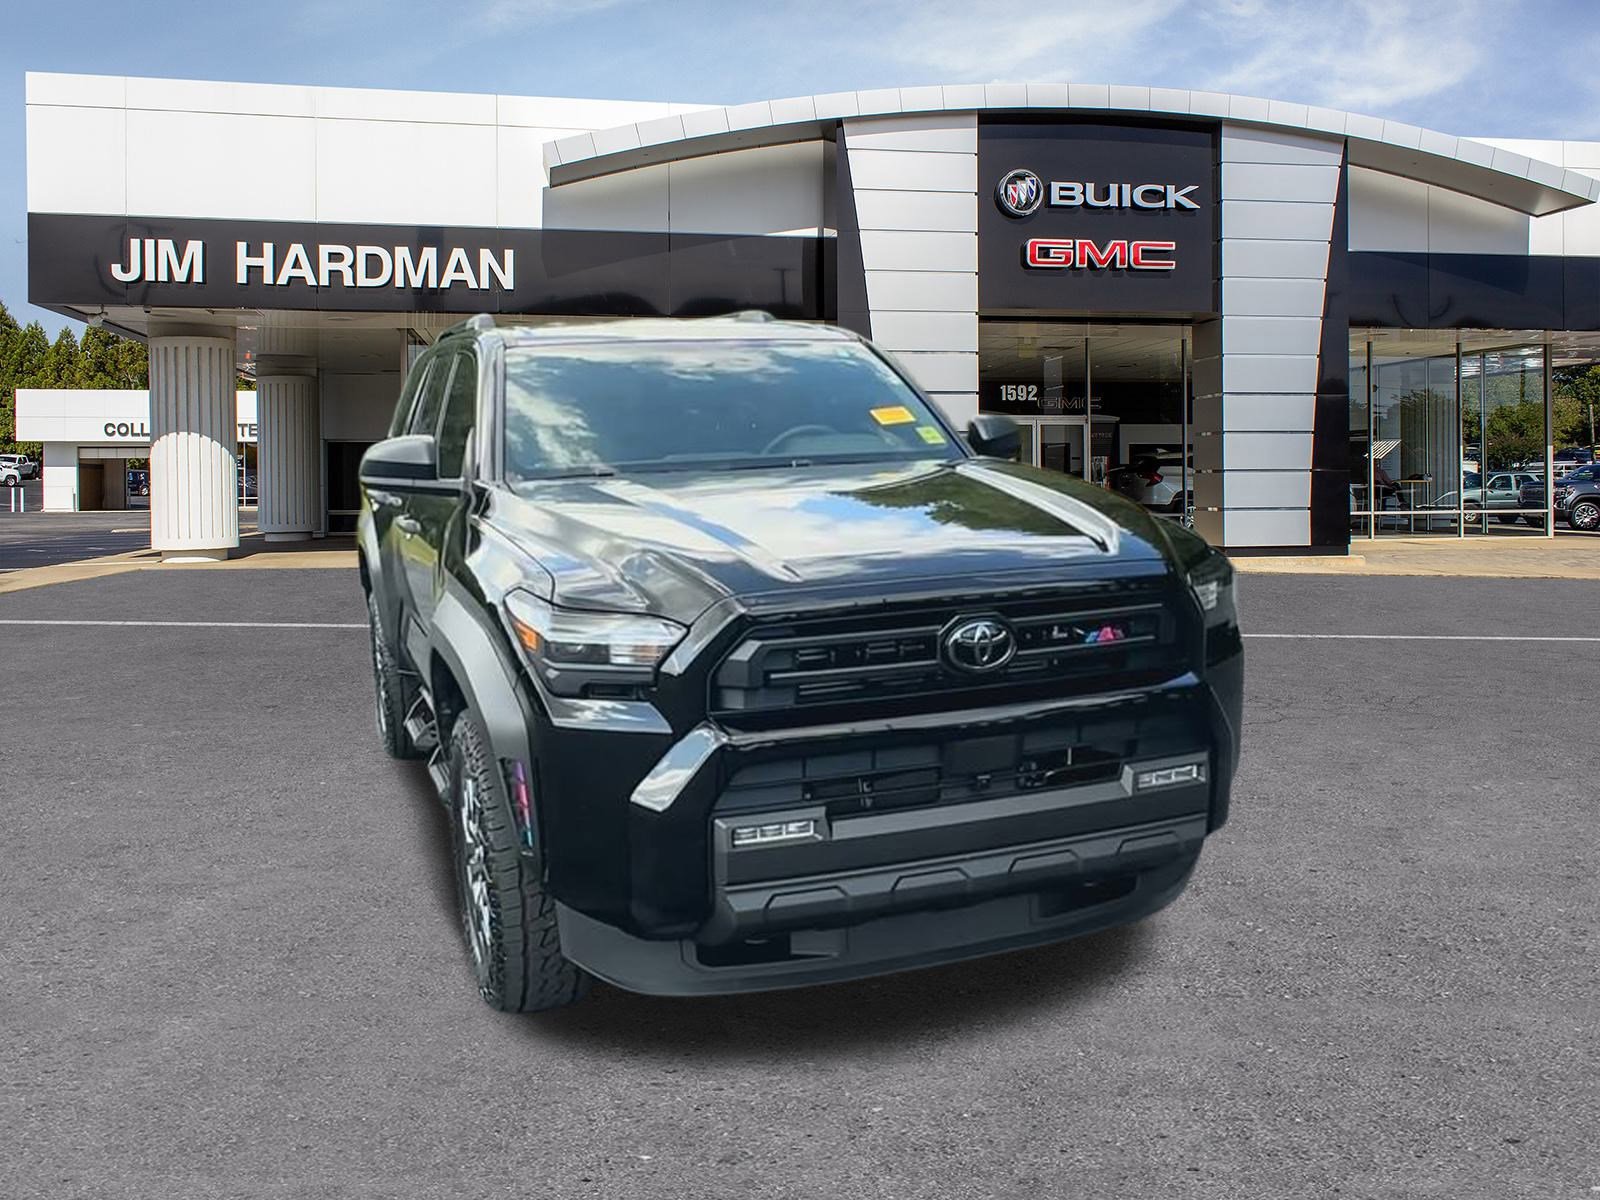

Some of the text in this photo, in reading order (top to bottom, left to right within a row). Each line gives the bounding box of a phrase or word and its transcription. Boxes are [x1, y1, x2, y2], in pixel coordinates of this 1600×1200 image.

[1050, 181, 1201, 209] BUICK
[111, 238, 516, 291] JIM HARDMAN
[1026, 237, 1177, 270] GMC
[1000, 384, 1038, 402] 1592
